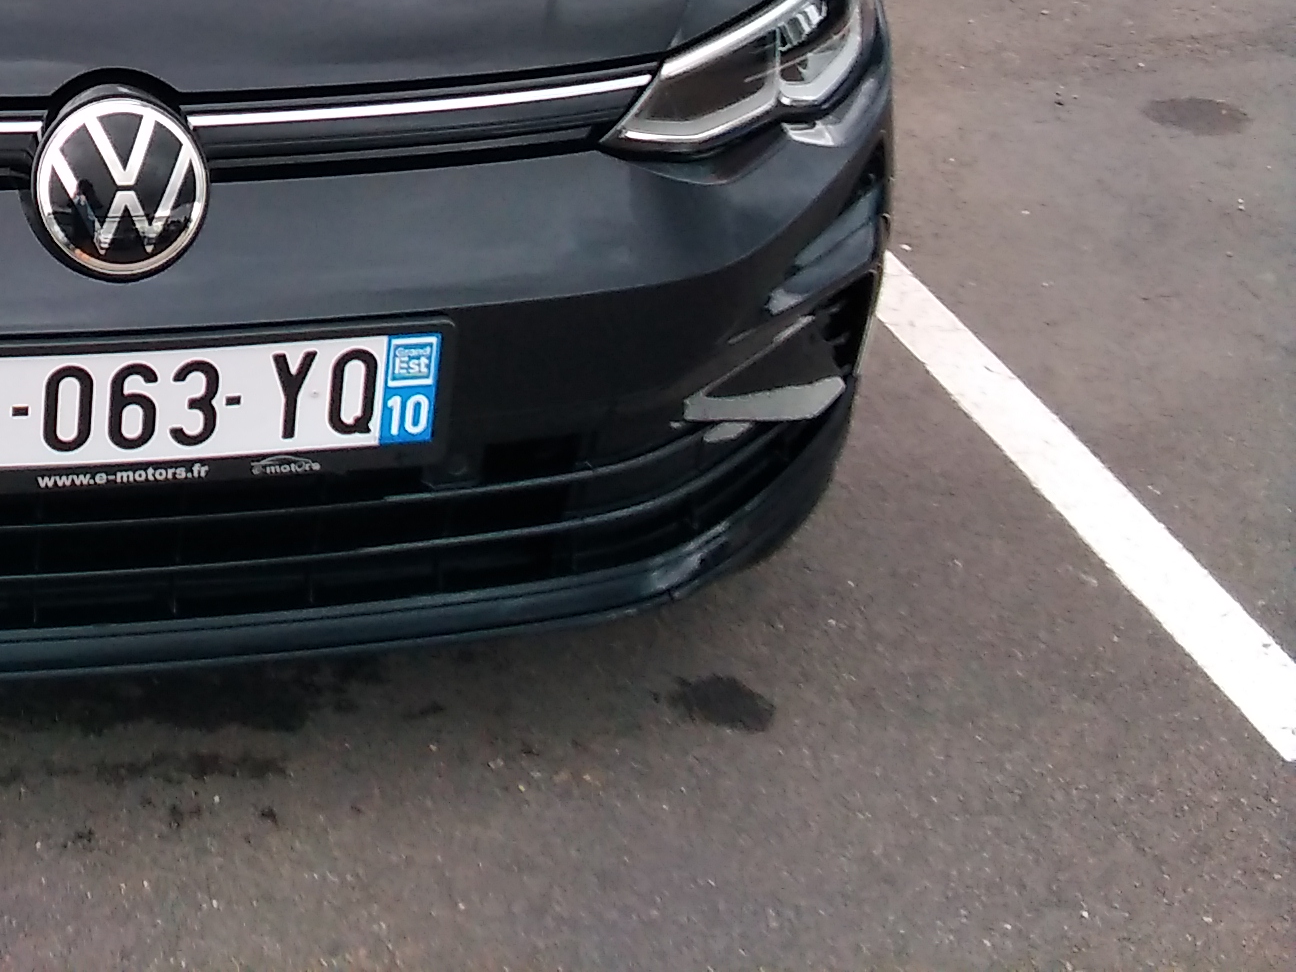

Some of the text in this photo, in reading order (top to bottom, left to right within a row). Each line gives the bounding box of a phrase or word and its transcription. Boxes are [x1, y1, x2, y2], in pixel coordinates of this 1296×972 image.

[394, 356, 429, 374] Est
[387, 394, 429, 436] 10
[36, 461, 210, 490] www.e-motors.fr
